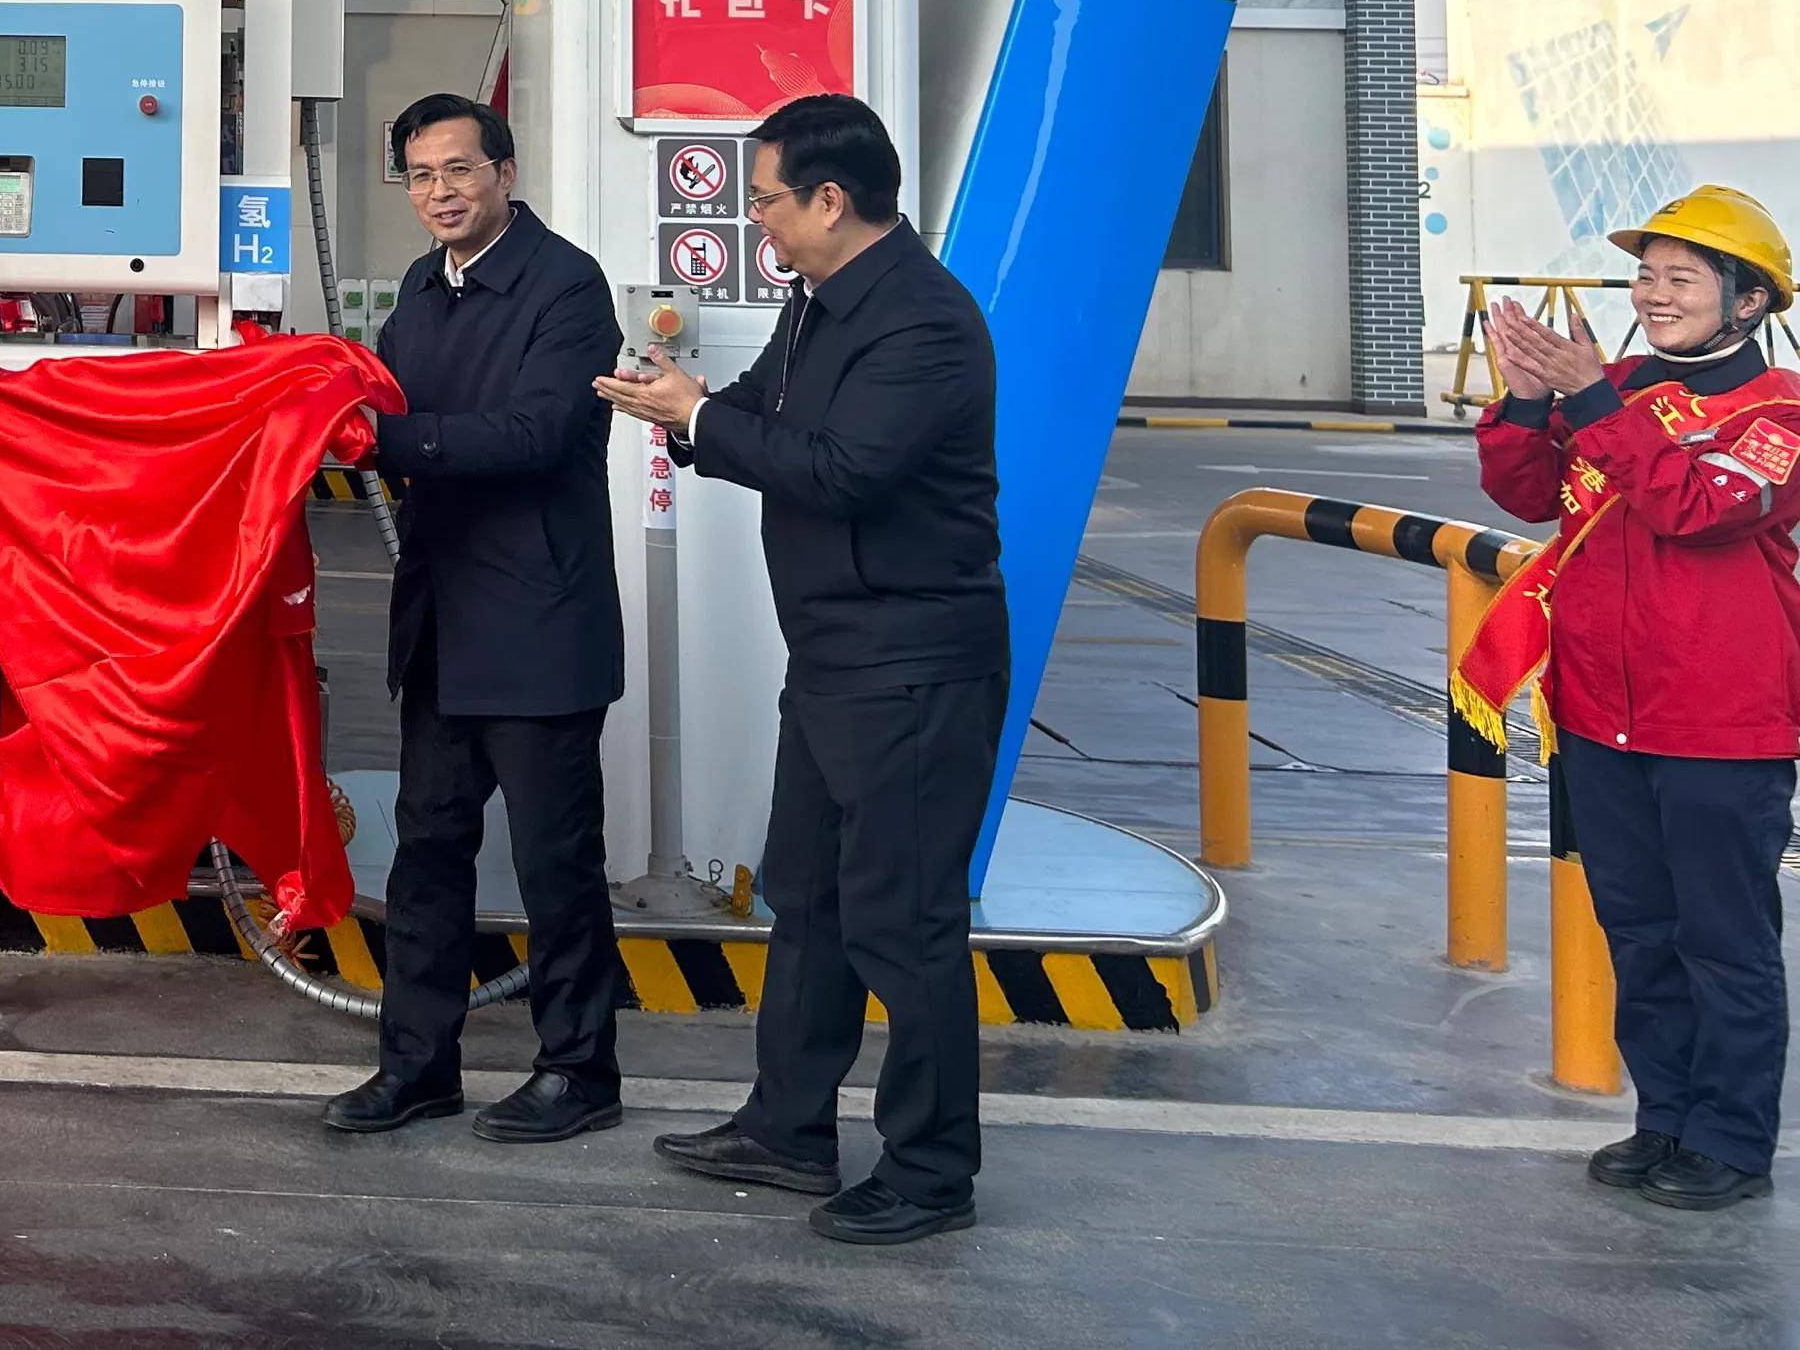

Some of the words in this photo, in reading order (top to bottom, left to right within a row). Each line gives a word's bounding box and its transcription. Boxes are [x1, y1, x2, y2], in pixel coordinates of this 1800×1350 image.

[238, 194, 271, 228] 氢
[670, 202, 728, 215] 严禁烟火
[233, 233, 274, 264] H2
